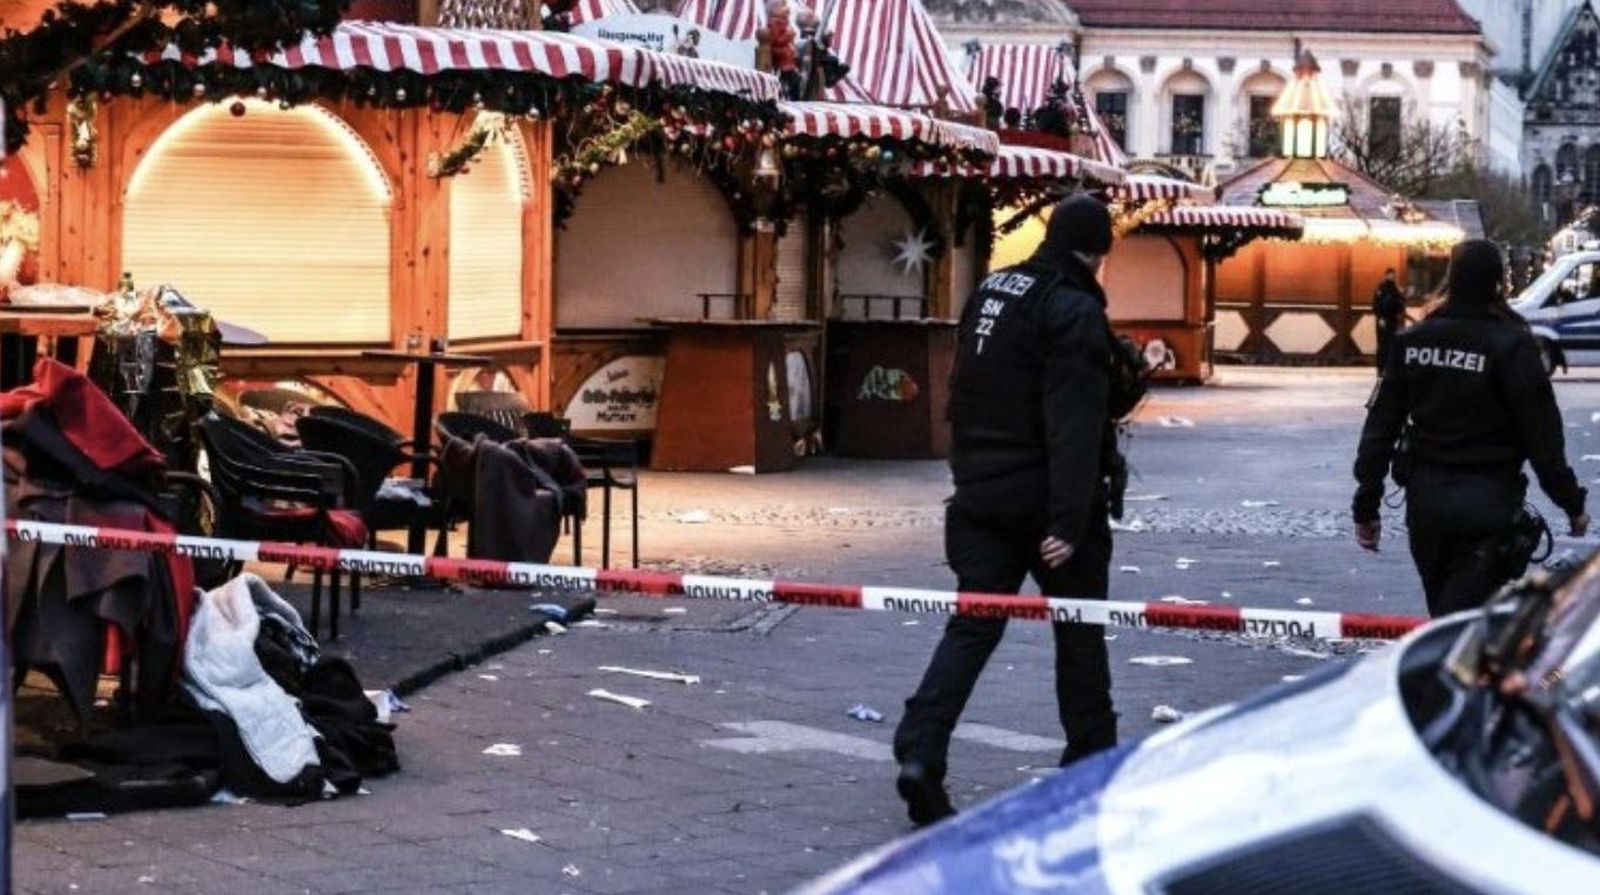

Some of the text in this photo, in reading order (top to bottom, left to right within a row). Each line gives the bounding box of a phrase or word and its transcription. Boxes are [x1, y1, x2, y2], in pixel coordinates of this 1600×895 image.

[980, 272, 1036, 296] POLIZEI
[981, 298, 1005, 317] SN
[975, 317, 996, 337] 22
[1404, 346, 1486, 373] POLIZEI
